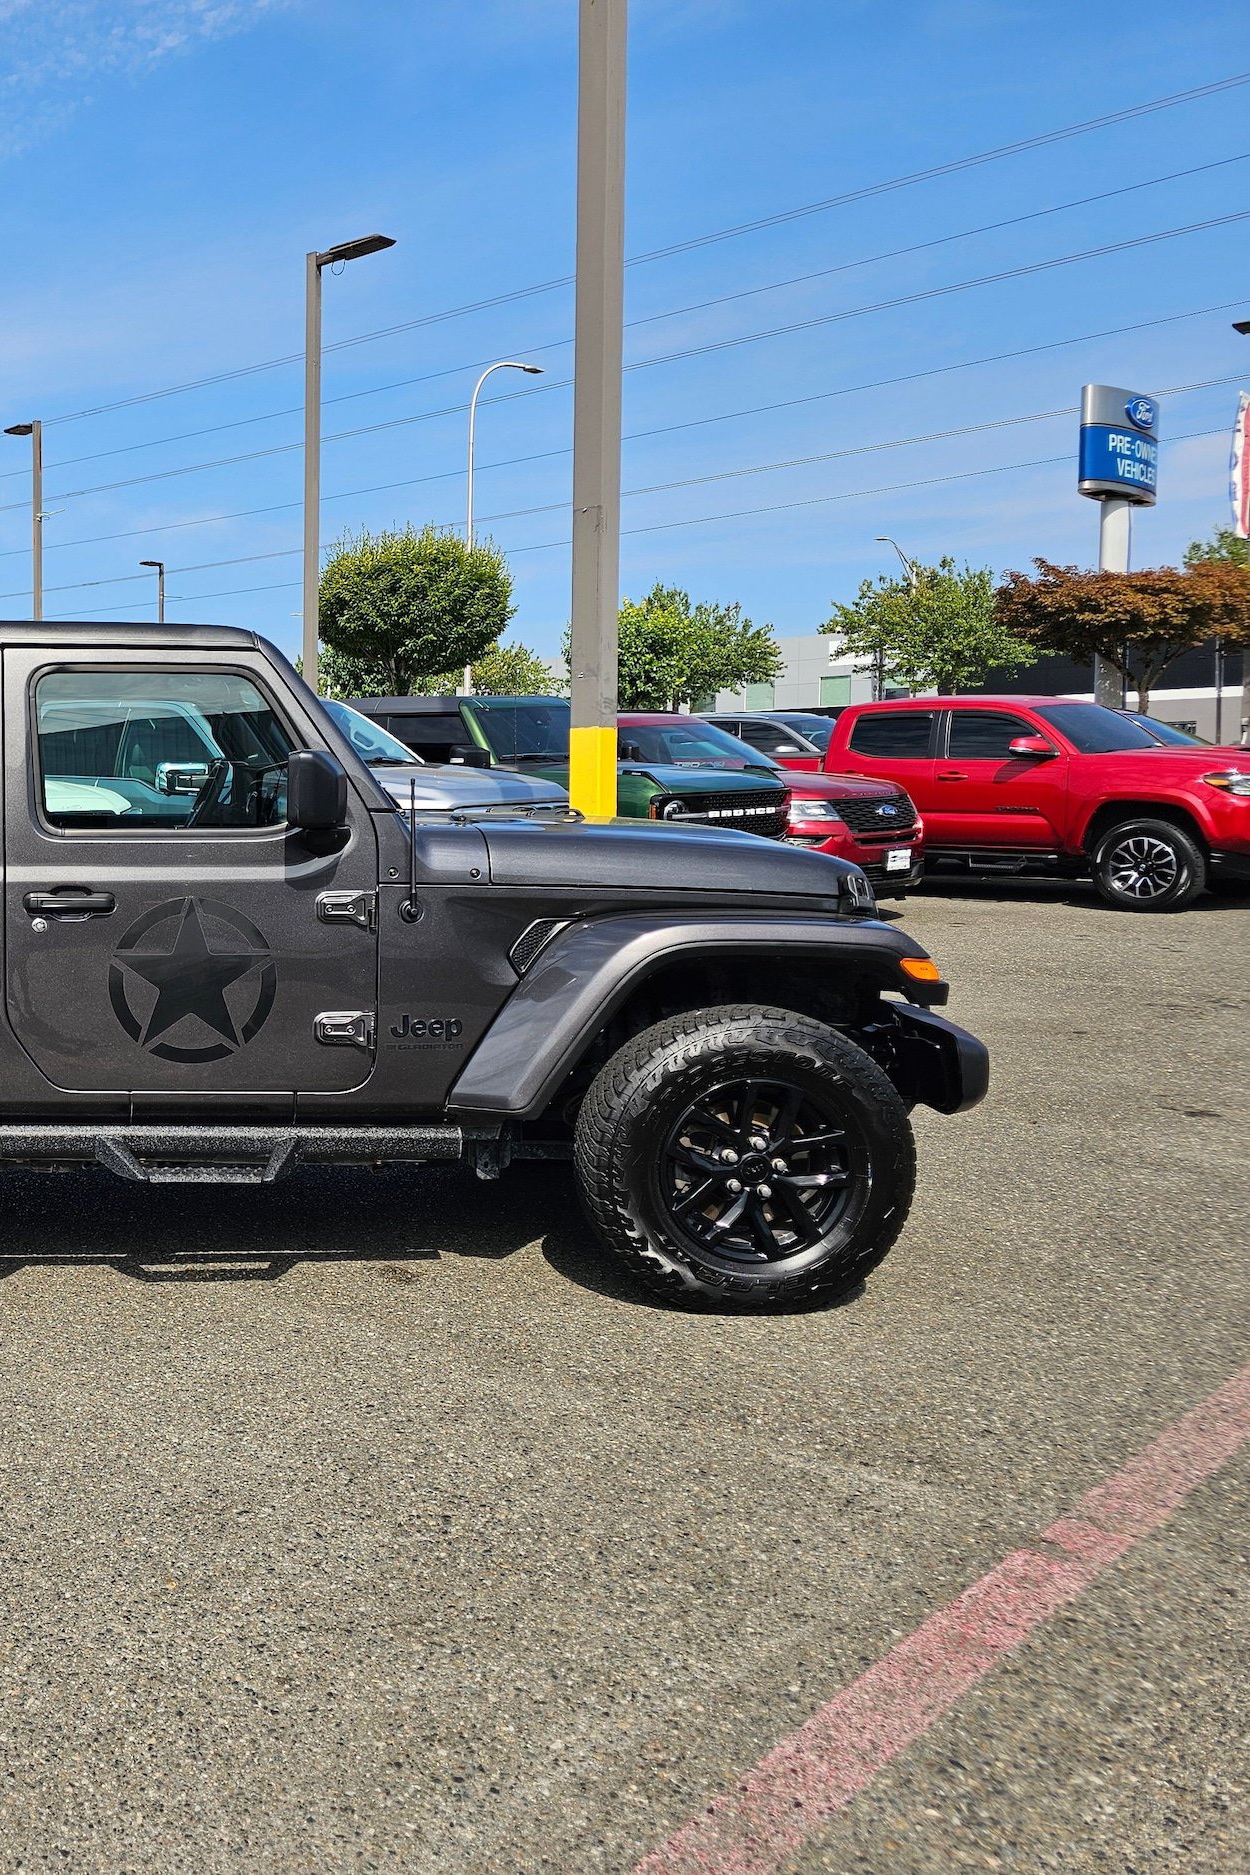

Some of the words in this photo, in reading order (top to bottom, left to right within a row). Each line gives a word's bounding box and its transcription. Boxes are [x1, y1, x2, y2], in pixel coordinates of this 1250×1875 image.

[1135, 402, 1154, 422] Ford
[1108, 433, 1158, 466] PRE-OWNE
[708, 806, 776, 818] BRONCO
[390, 1013, 463, 1041] Jeep
